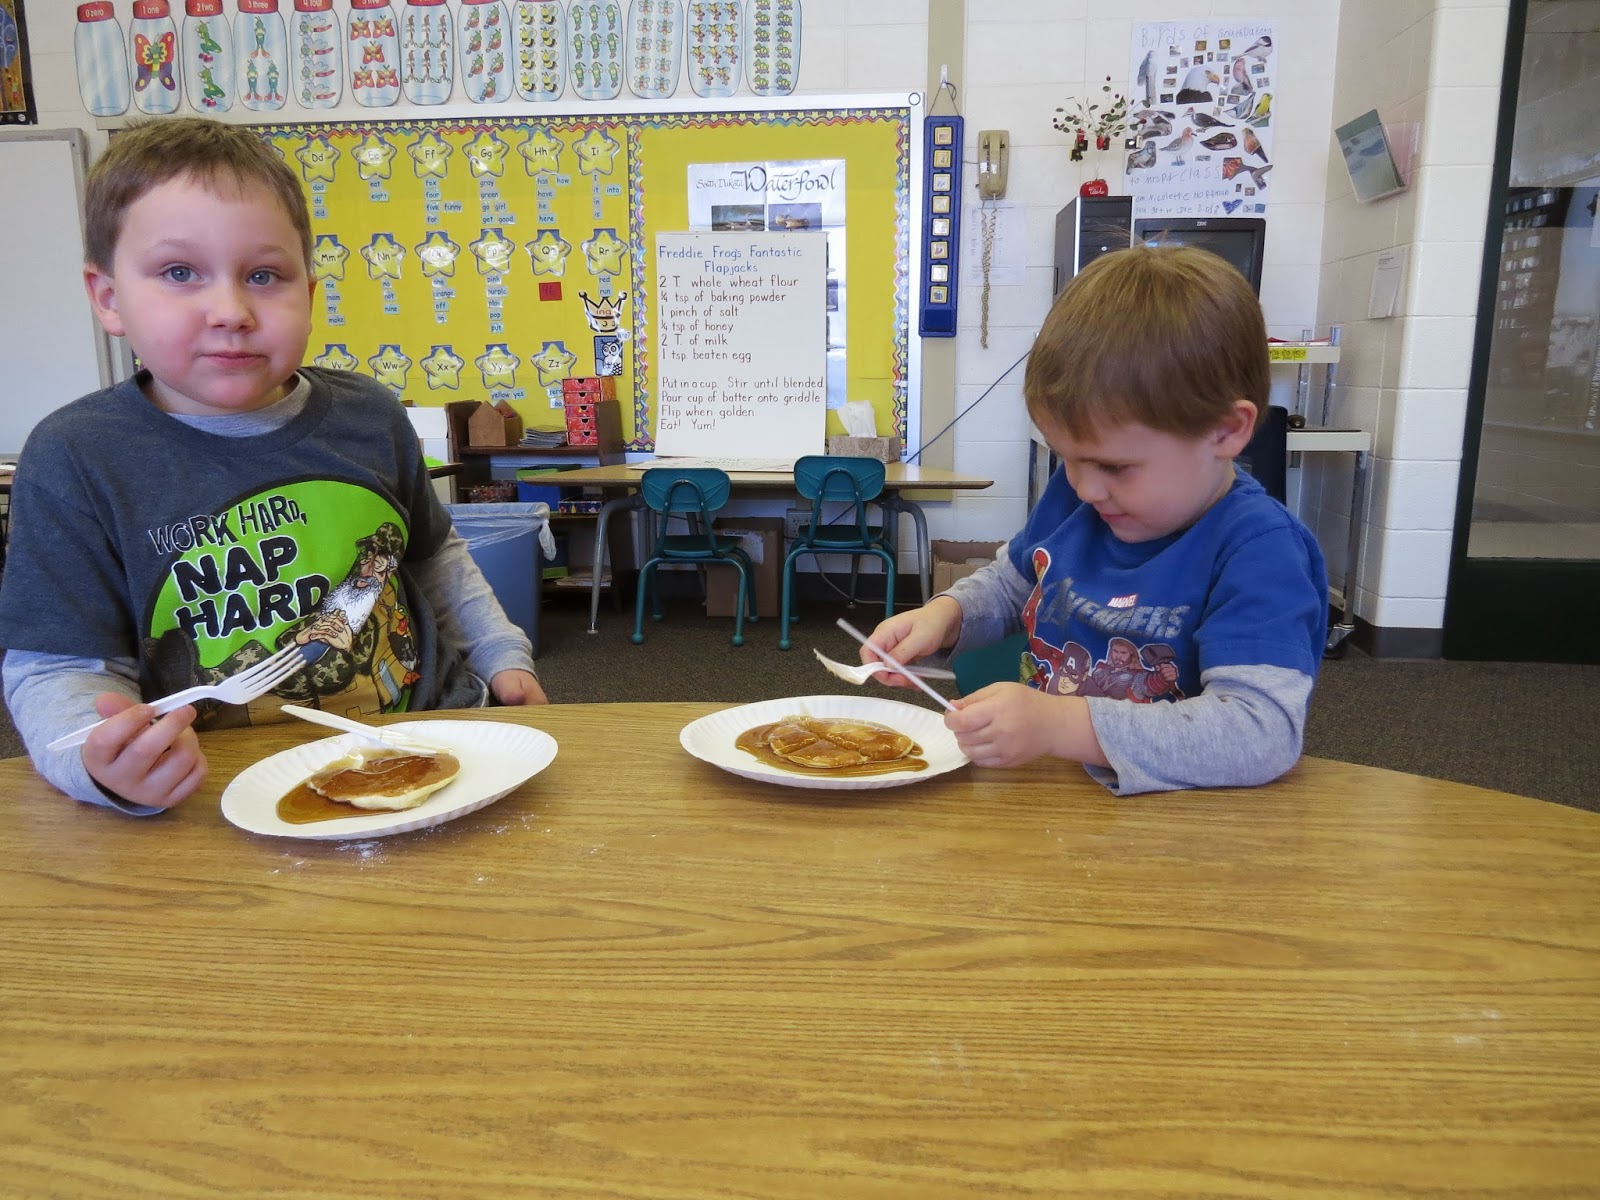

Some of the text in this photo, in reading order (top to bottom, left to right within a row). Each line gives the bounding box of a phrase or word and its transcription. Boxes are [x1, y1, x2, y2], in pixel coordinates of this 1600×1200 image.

[196, 3, 214, 12] 2 two
[248, 1, 269, 9] 3 three
[85, 10, 90, 18] 0
[425, 150, 435, 159] Ff
[480, 148, 493, 160] Gg
[534, 147, 548, 156] Hh
[591, 147, 600, 156] Ii
[312, 153, 324, 162] Dd
[480, 180, 495, 188] gray
[730, 166, 837, 201] Waterfowl
[371, 193, 387, 201] eight
[494, 203, 506, 212] girl
[483, 216, 494, 224] get
[498, 216, 514, 224] good
[599, 247, 610, 256] Rr
[659, 245, 803, 261] Freddie Frog's Fantastic
[321, 254, 337, 262] Mm
[377, 252, 391, 261] Nn
[704, 261, 758, 276] Flapjacks
[659, 276, 667, 288] 2
[691, 275, 722, 288] whole
[730, 275, 764, 288] wheat
[771, 275, 800, 288] flour
[675, 292, 689, 304] tsp
[694, 291, 705, 303] of
[711, 290, 744, 305] baking
[750, 290, 787, 304] powder
[661, 305, 739, 319] 1 pinch of salt
[329, 316, 345, 324] make
[672, 321, 685, 333] tsp
[690, 319, 700, 331] of
[705, 319, 734, 334] honey
[661, 334, 668, 347] 2
[689, 334, 700, 346] of
[705, 333, 729, 346] milk
[663, 348, 752, 363] 1 tsp. beaten egg
[331, 361, 342, 370] Vv
[382, 362, 398, 370] Ww
[437, 363, 449, 372] Xx
[492, 363, 504, 373] Yy
[548, 360, 560, 368] Zz
[662, 376, 678, 389] Put
[680, 380, 690, 388] in
[728, 376, 749, 389] Stir
[754, 376, 779, 389] until
[491, 391, 510, 400] yellow
[661, 391, 821, 406] Pour cup of batter onto griddle
[661, 405, 681, 419] Flip
[685, 405, 713, 417] when
[660, 418, 716, 431] Eat! Yum!
[148, 495, 308, 555] WORK HARD,
[171, 535, 298, 603] NAP
[1107, 594, 1138, 608] MARVEL
[174, 574, 330, 640] HARD
